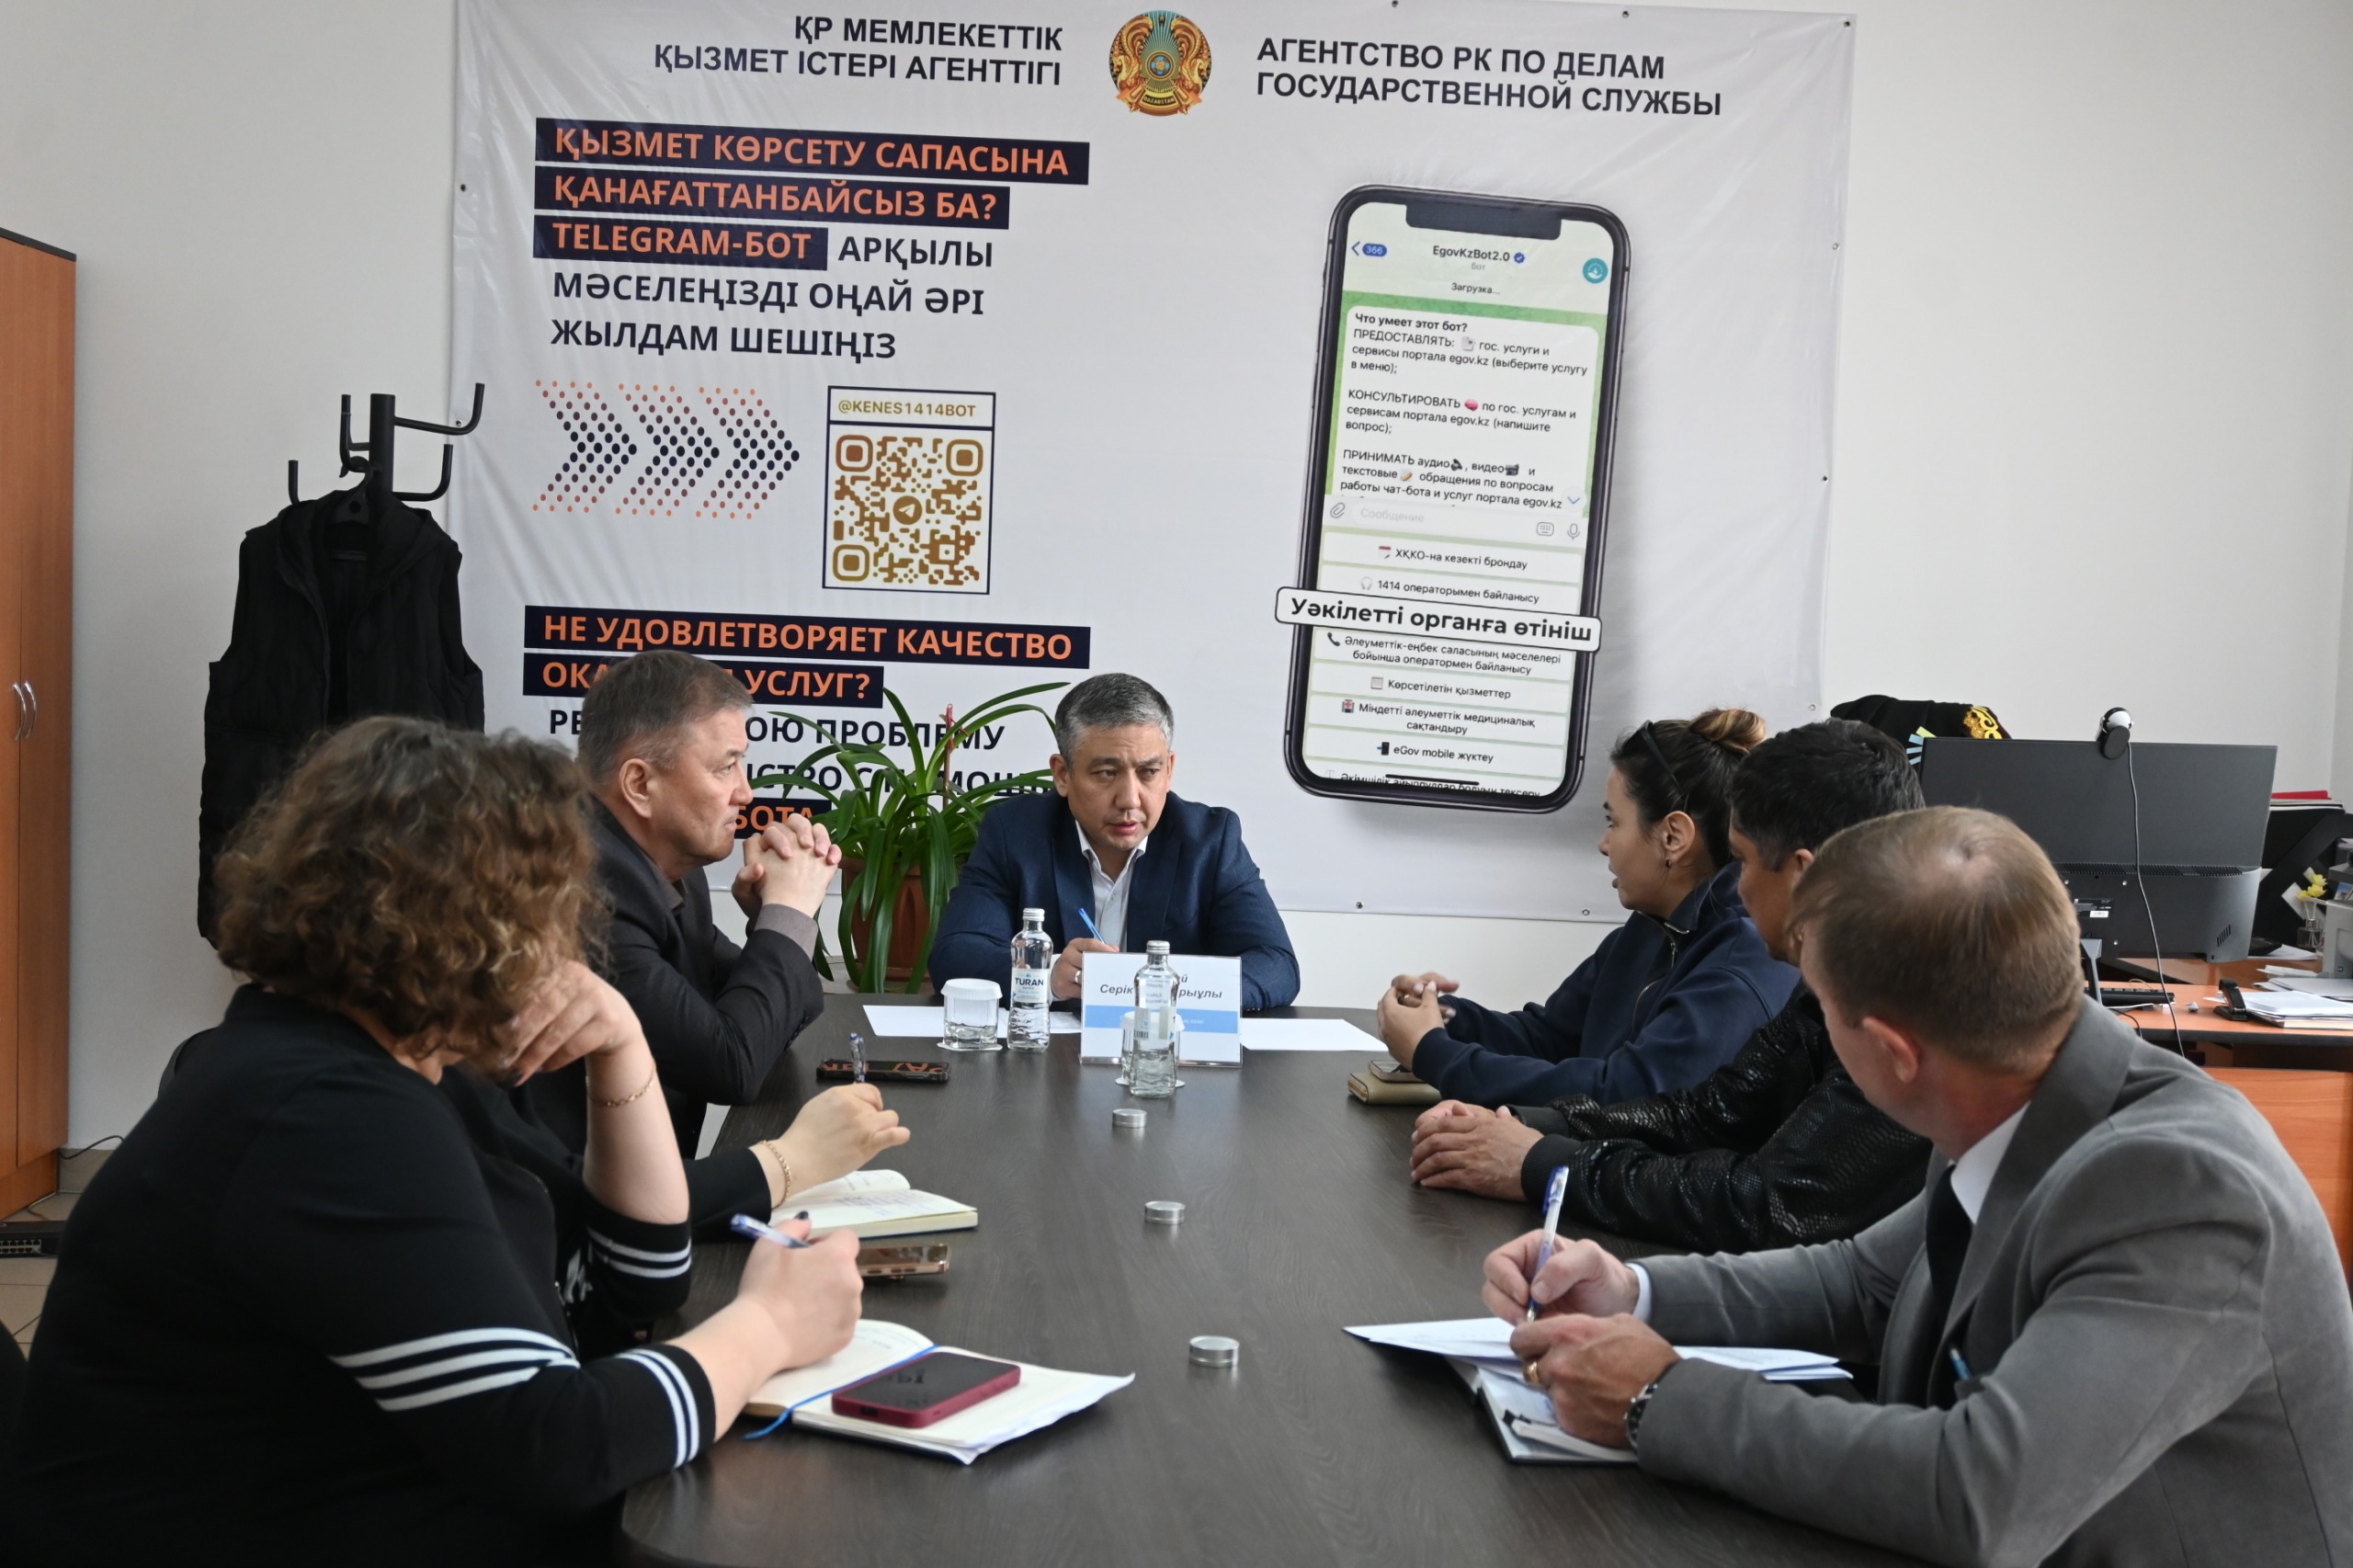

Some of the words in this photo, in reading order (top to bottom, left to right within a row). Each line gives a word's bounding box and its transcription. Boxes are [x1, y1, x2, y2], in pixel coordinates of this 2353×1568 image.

[796, 16, 833, 44] ҚР
[844, 18, 1063, 51] МЕМЛЕКЕТТІК
[655, 44, 789, 73] ҚЫЗМЕТ
[799, 51, 895, 78] ІСТЕРІ
[905, 56, 1060, 85] АГЕНТТІГІ
[1257, 38, 1443, 69] АГЕНТСТВО
[1454, 47, 1492, 71] РК
[1502, 50, 1545, 74] ПО
[1553, 51, 1664, 80] ДЕЛАМ
[1257, 72, 1571, 109] ГОСУДАРСТВЕННОЙ
[1583, 87, 1721, 115] СЛУЖБЫ
[557, 128, 703, 160] ҚЫЗМЕТ
[715, 135, 865, 165] КӨРСЕТУ
[876, 142, 1068, 175] САПАСЫНА
[554, 175, 925, 216] ҚАНАҒАТТАНБАЙСЫЗ
[938, 192, 995, 220] БА?
[552, 223, 811, 258] TELEGRAM-БОТ
[838, 236, 992, 270] АРҚЫЛЫ
[1365, 245, 1383, 255] 366
[1433, 245, 1510, 261] EgovKzBot2.0
[554, 272, 798, 313] МӘСЕЛЕҢІЗДІ
[810, 278, 911, 316] ОҢАЙ
[926, 288, 983, 314] ӘРІ
[1356, 313, 1375, 324] Что
[1379, 318, 1412, 326] умеет
[1415, 321, 1439, 329] этот
[1442, 321, 1467, 332] бот?
[551, 320, 717, 356] ЖЫЛДАМ
[732, 327, 895, 364] ШЕШІҢІЗ
[1354, 329, 1454, 347] ПРЕДОСТАВЛЯТЬ:
[1504, 346, 1540, 356] услуги
[1351, 360, 1358, 369] в
[1360, 362, 1397, 374] меню);
[1352, 347, 1399, 357] сервисы
[1403, 351, 1446, 361] портала
[1449, 356, 1488, 366] egov.kz
[1493, 358, 1548, 370] (выберите
[1552, 365, 1587, 376] услугу
[838, 400, 976, 416] @KENES1414BOT
[1348, 390, 1461, 408] КОНСУЛЬТИРОВАТЬ
[1482, 403, 1496, 412] по
[1523, 407, 1566, 417] услугам
[1569, 411, 1576, 419] и
[1346, 422, 1392, 434] вопрос);
[1347, 406, 1400, 417] сервисам
[1404, 412, 1447, 422] портала
[1450, 416, 1489, 426] egov.kz
[1494, 418, 1551, 432] (напишите
[1344, 449, 1415, 465] ПРИНИМАТЬ
[1343, 467, 1397, 478] текстовые
[1420, 472, 1481, 485] обращения
[1483, 479, 1497, 488] по
[1500, 481, 1553, 492] вопросам
[1341, 481, 1380, 492] работы
[1383, 485, 1430, 496] чат-бота
[1433, 489, 1441, 498] и
[1444, 492, 1472, 502] услуг
[1476, 494, 1519, 505] портала
[1523, 498, 1562, 508] egov.kz
[1396, 549, 1442, 561] ХҚКО-на
[1445, 556, 1481, 564] кезекті
[1484, 557, 1527, 570] брондау
[1379, 581, 1400, 590] 1414
[1404, 585, 1480, 597] операторымен
[1483, 590, 1539, 604] байланысу
[1291, 598, 1404, 624] Уәкілетті
[1411, 613, 1506, 633] органға
[1515, 619, 1591, 641] өтініш
[545, 616, 585, 641] НЕ
[597, 618, 887, 654] УДОВЛЕТВОРЯЕТ
[898, 629, 1071, 659] КАЧЕСТВО
[1345, 636, 1438, 653] Әлеуметтік-еңбек
[1441, 647, 1498, 659] саласының
[1502, 652, 1560, 664] мәселелері
[1353, 651, 1400, 663] бойынша
[1404, 656, 1472, 668] оператормен
[1475, 661, 1531, 676] байланысу
[746, 669, 870, 699] УСЛУГ?
[1389, 680, 1452, 693] Көрсетілетін
[1456, 687, 1511, 699] қызметтер
[1359, 703, 1402, 714] Міндетті
[1405, 709, 1461, 720] әлеуметтік
[1464, 714, 1535, 728] медициналық
[1407, 722, 1467, 735] сақтандыру
[815, 720, 1006, 750] ПРОБЛЕМУ
[1393, 746, 1419, 755] eGov
[1422, 749, 1455, 758] mobile
[1458, 753, 1494, 764] жүктеу
[1015, 977, 1044, 986] TURAN
[1100, 983, 1133, 995] Серік
[1178, 987, 1222, 999] рыұлы
